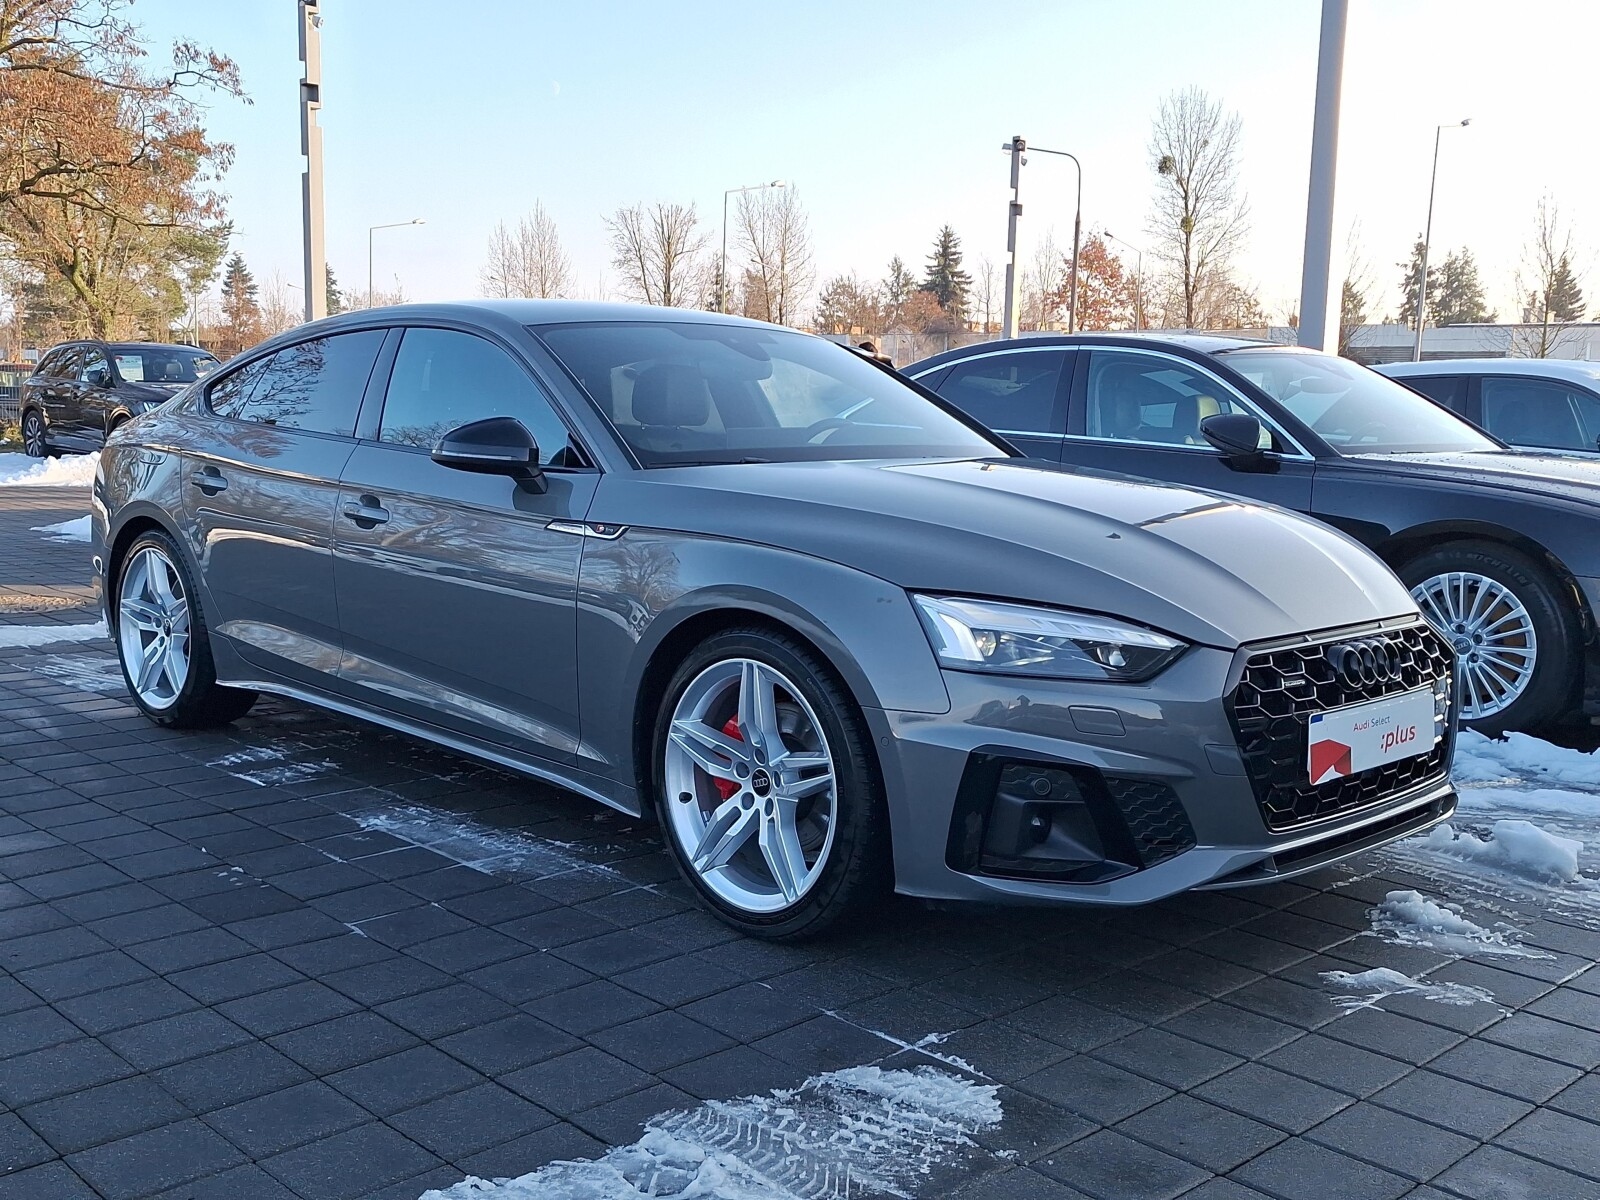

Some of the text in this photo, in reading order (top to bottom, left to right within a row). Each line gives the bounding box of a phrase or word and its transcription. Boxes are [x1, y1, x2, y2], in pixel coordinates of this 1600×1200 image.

[1353, 716, 1391, 731] Audi Select
[1380, 725, 1416, 754] :plus
